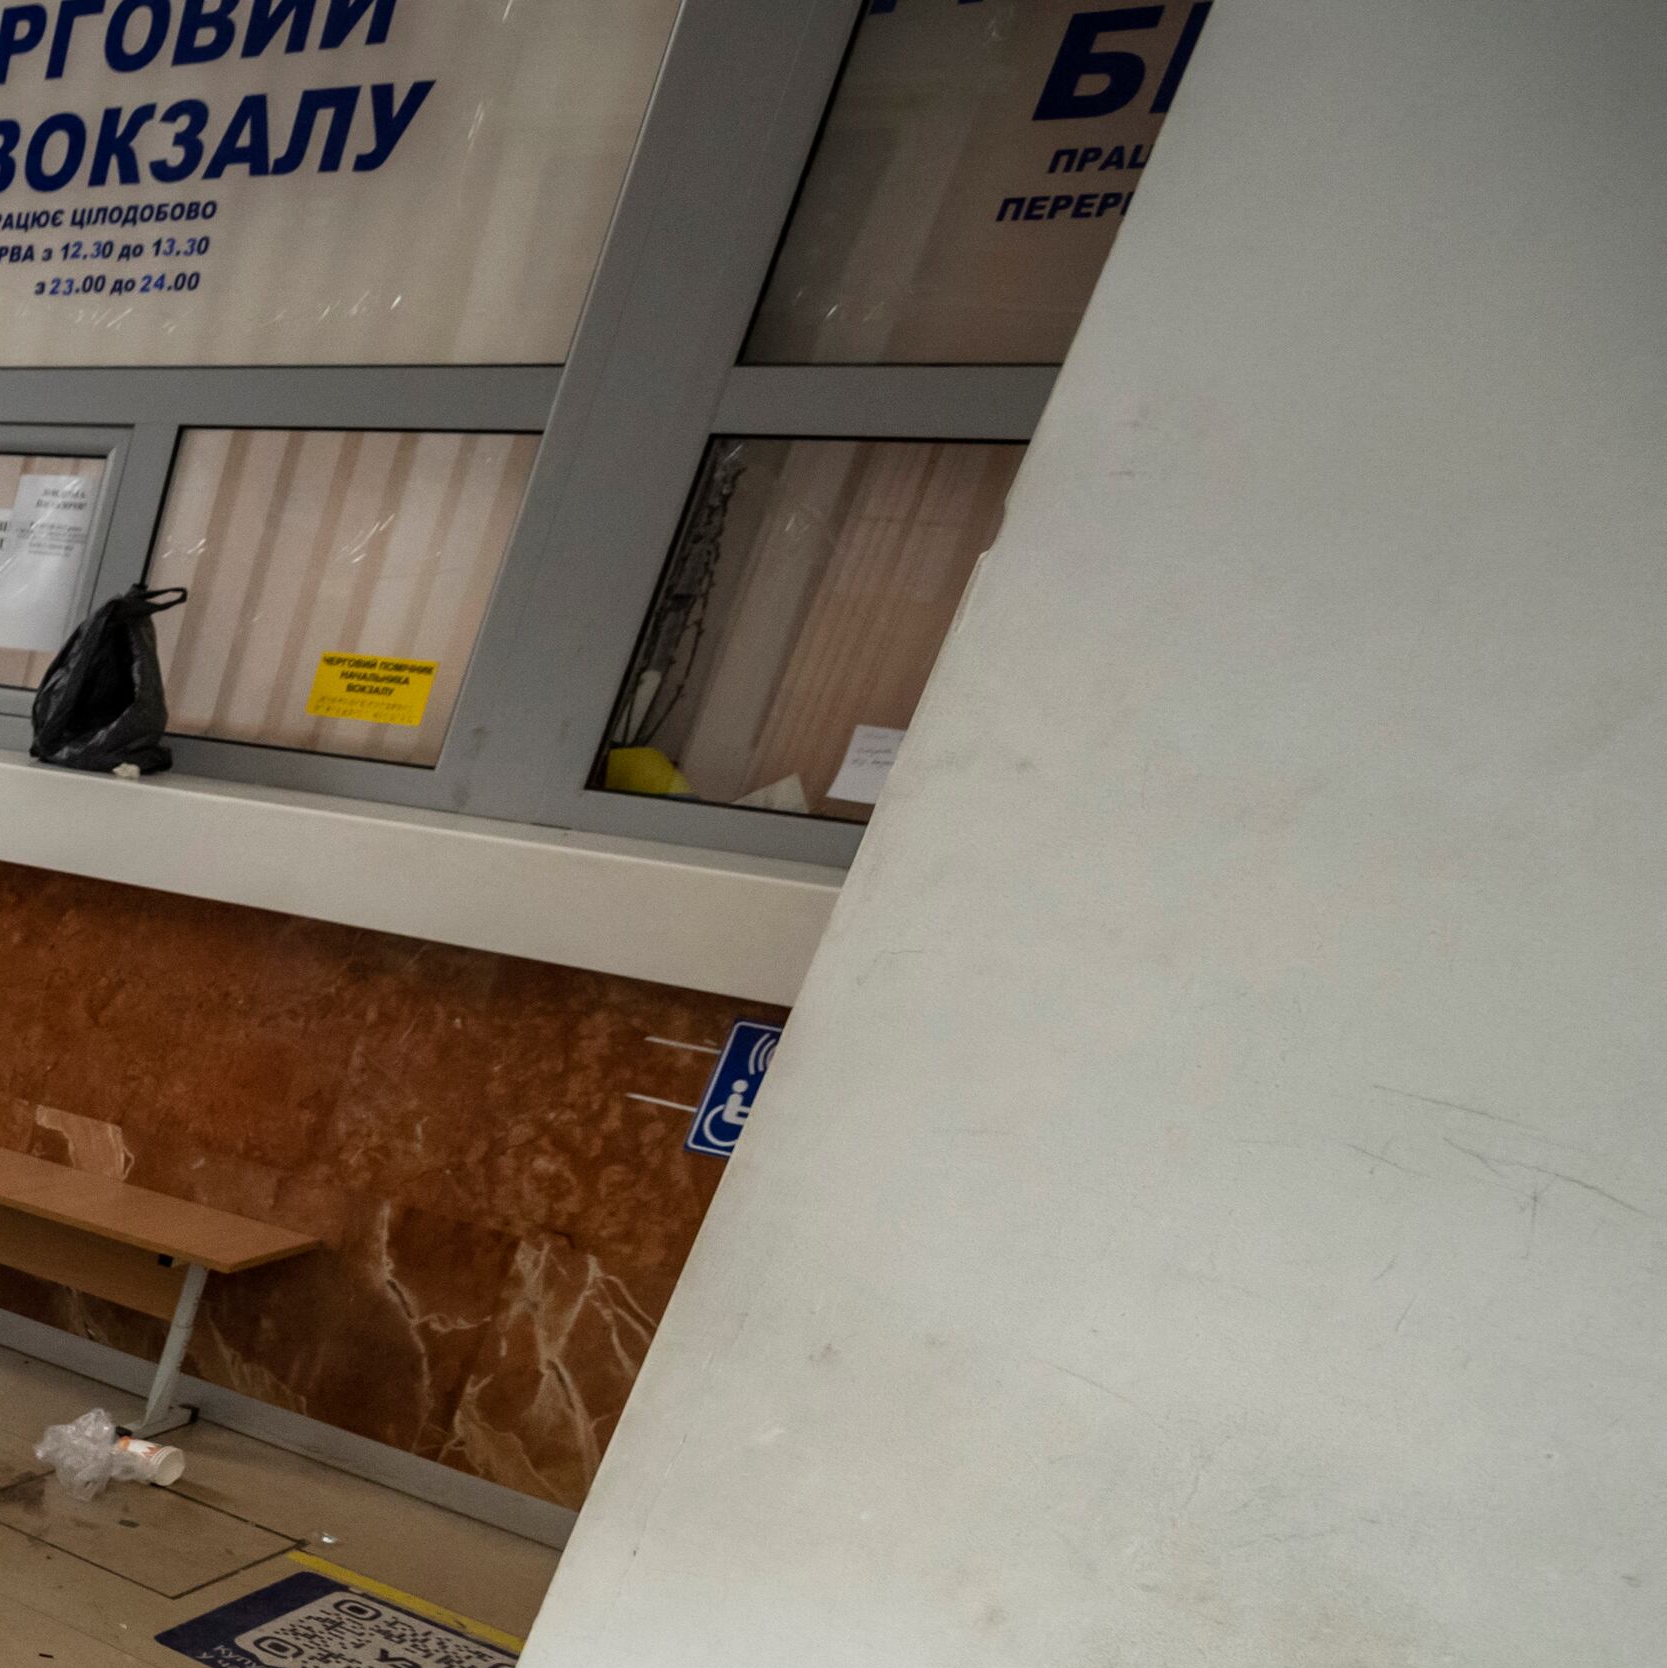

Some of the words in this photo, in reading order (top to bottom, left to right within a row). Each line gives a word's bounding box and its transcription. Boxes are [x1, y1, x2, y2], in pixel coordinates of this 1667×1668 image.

[71, 201, 217, 229] ЦІЛОДОБОВО
[61, 240, 114, 262] 12.30
[118, 241, 144, 262] до
[152, 236, 209, 258] 13.30
[48, 273, 105, 296] 23.00
[110, 274, 136, 296] до
[140, 272, 201, 293] 24.00
